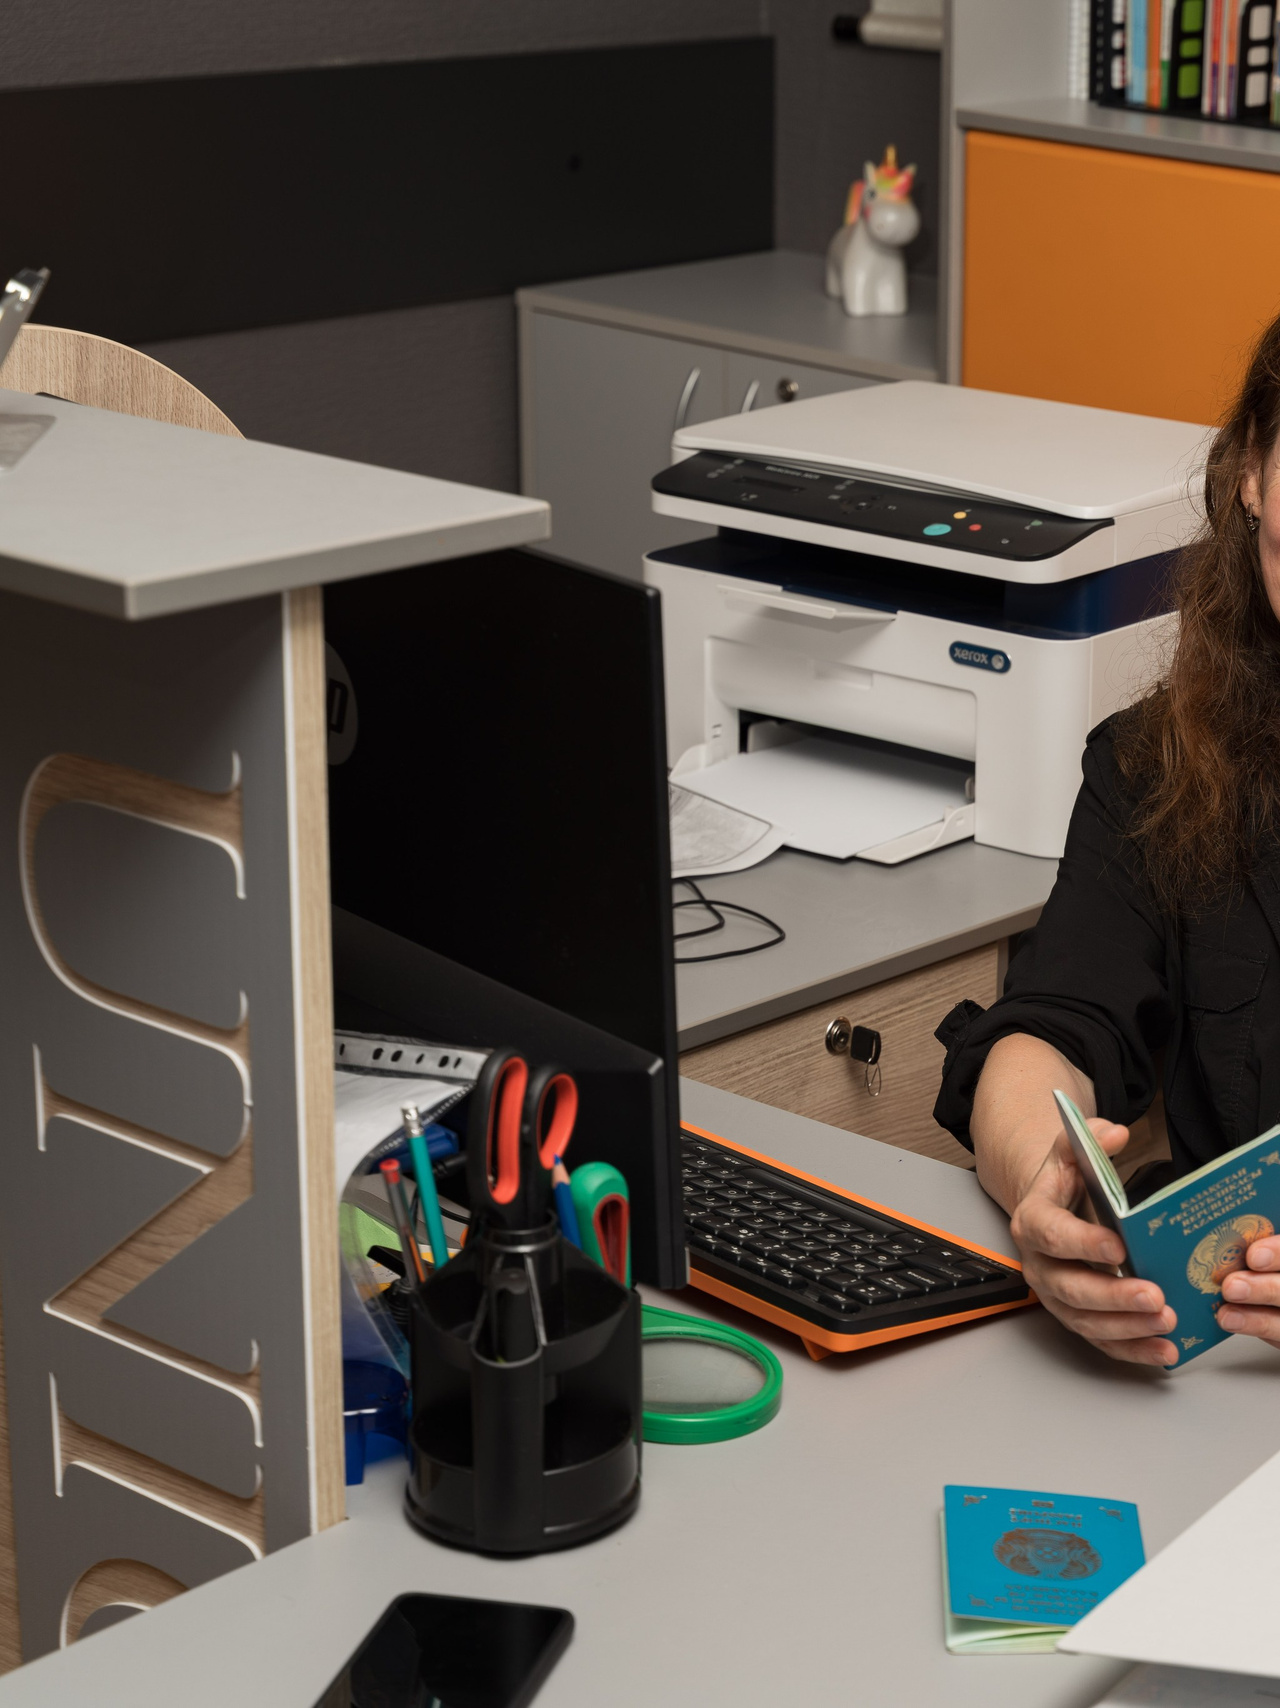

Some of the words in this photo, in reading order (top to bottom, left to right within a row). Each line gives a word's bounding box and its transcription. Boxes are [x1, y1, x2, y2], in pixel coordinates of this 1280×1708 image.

[953, 647, 989, 665] xerox
[1181, 1192, 1237, 1227] REPUBLIC
[1238, 1182, 1255, 1196] OF
[1183, 1189, 1257, 1237] KAZAKHSTAN
